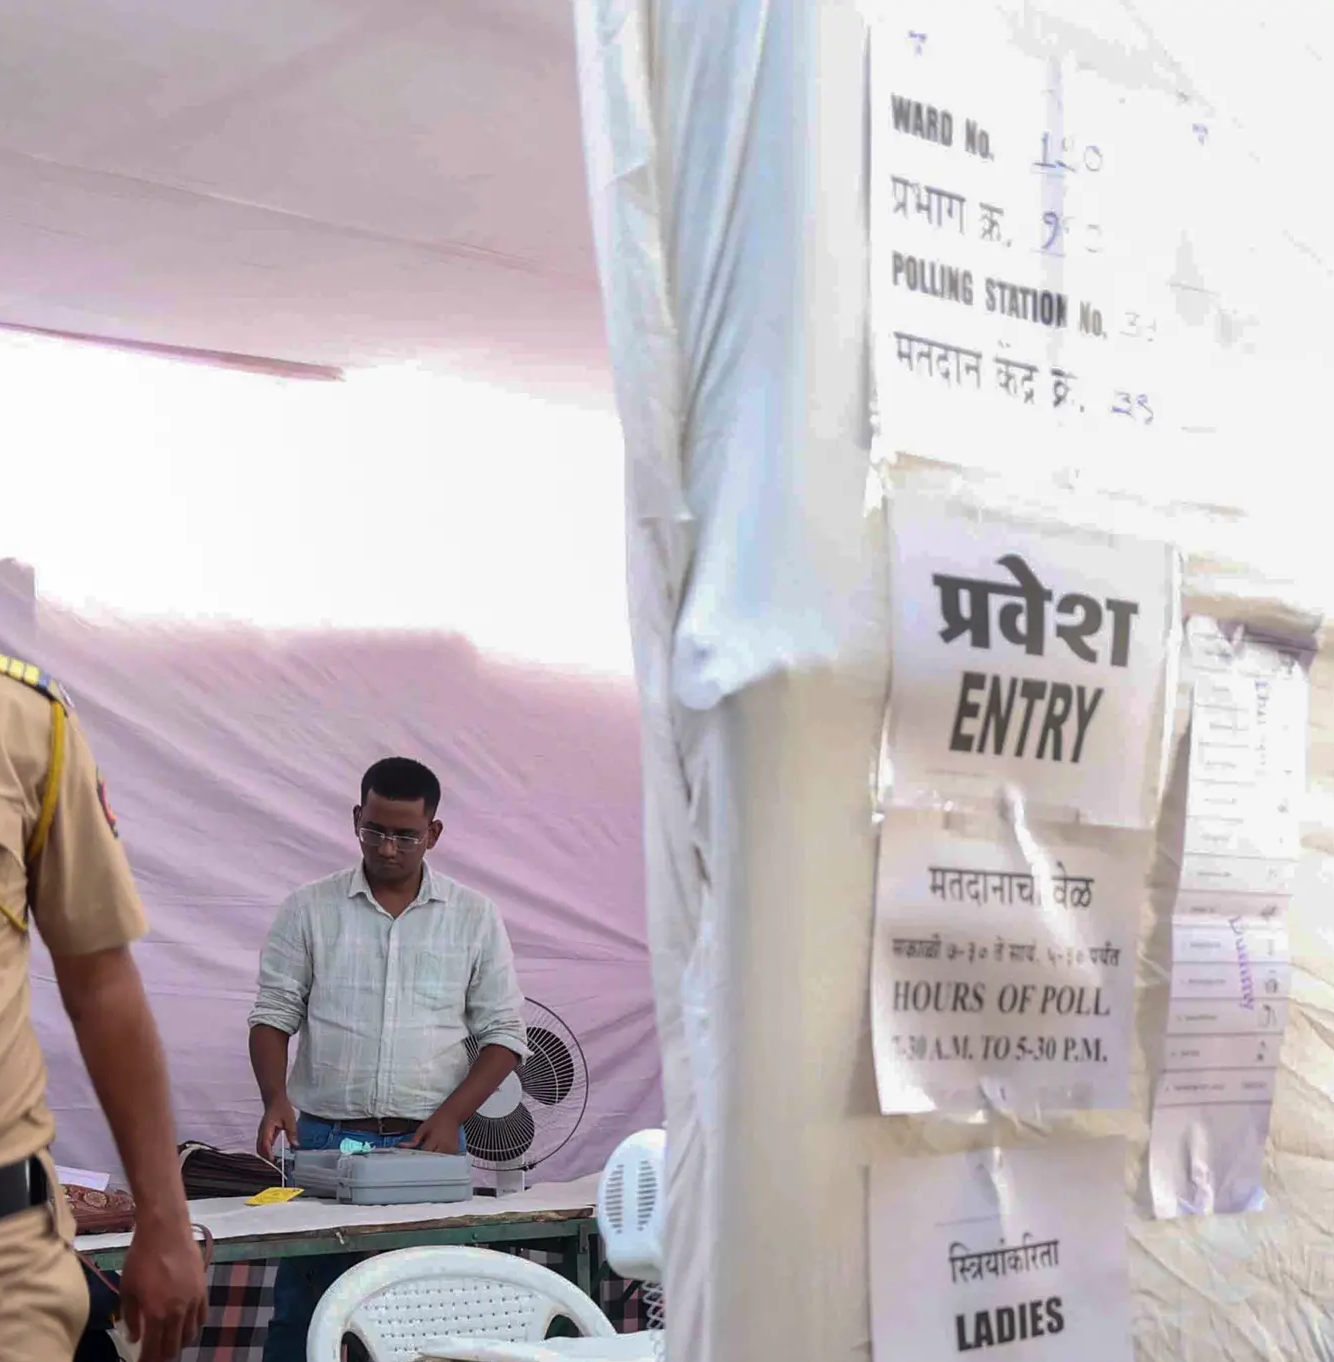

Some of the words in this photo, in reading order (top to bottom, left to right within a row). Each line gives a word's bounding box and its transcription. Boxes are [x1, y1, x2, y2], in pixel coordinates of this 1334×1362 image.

[891, 94, 954, 147] WARD
[965, 117, 995, 161] No.
[891, 175, 966, 234] प्रभाग
[892, 250, 973, 306] POLLING
[985, 277, 1068, 328] STATION
[1078, 300, 1108, 340] No.
[893, 331, 983, 389] मतदान
[932, 554, 1139, 667] प्रवेश
[949, 671, 1104, 763] ENTRY
[928, 866, 1037, 907] मतदानाच
[892, 980, 986, 1014] HOURS
[998, 984, 1036, 1015] OF
[1039, 985, 1111, 1016] POLL
[929, 1035, 974, 1062] A.M.
[981, 1035, 1011, 1061] TO
[1015, 1035, 1057, 1062] 5-30
[1063, 1036, 1109, 1063] P.M.
[948, 1231, 1060, 1283] स्त्रियांकरिता
[955, 1297, 1064, 1353] LADIES
